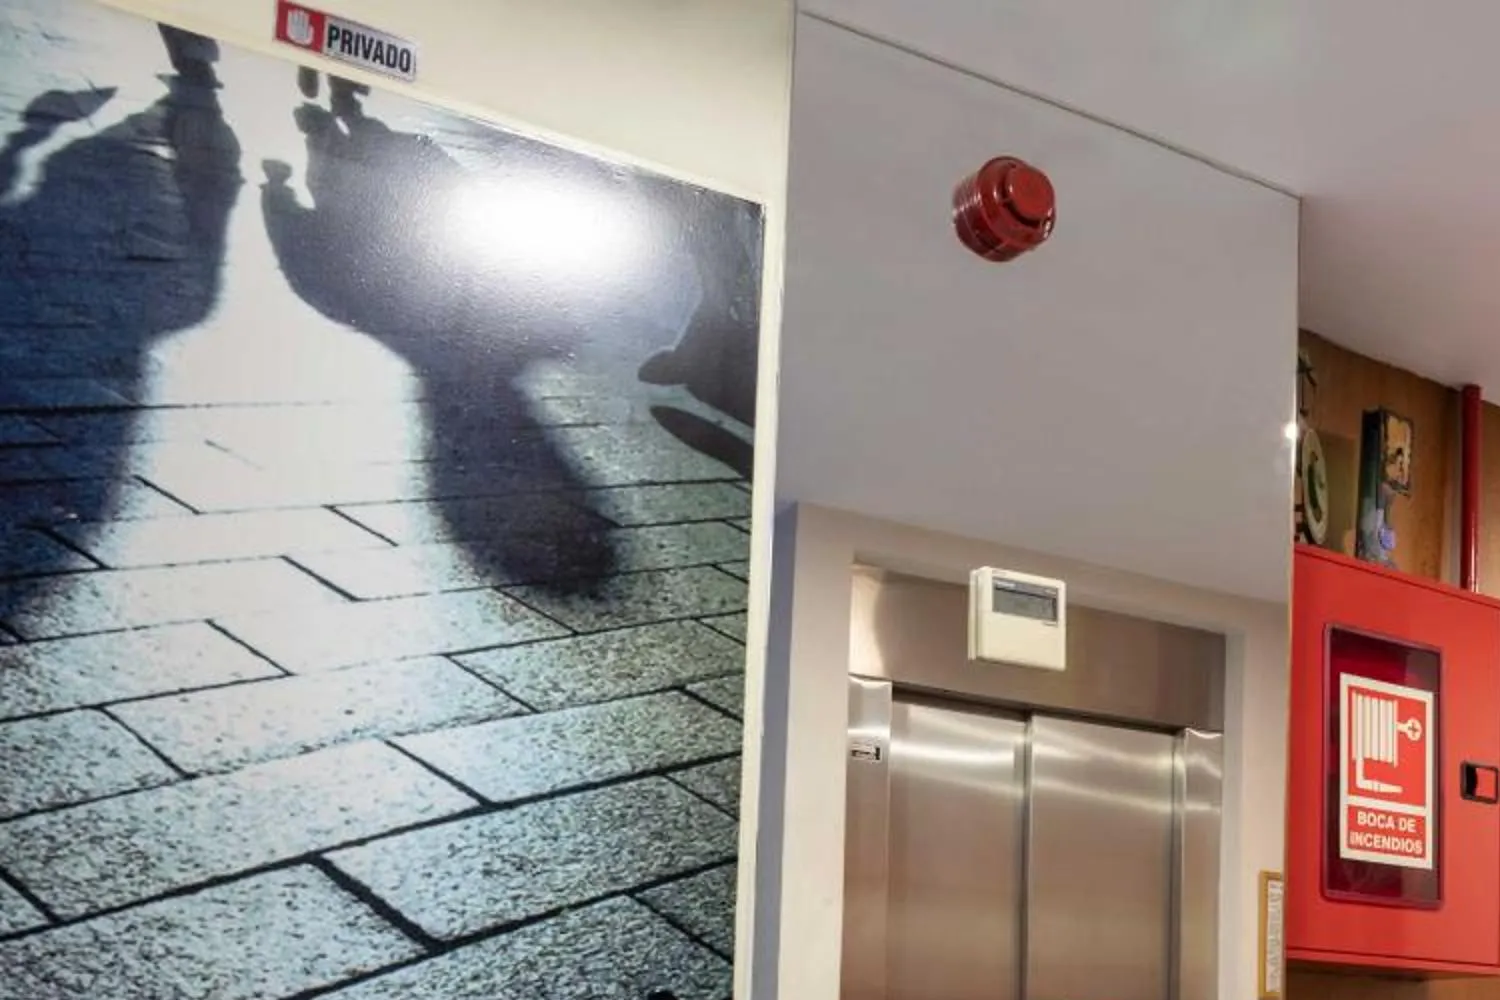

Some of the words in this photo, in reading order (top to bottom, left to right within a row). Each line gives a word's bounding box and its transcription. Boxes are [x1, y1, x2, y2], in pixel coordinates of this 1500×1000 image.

[327, 23, 412, 73] PRIVADO
[1357, 811, 1395, 831] BOCA
[1399, 817, 1417, 833] DE
[1349, 831, 1423, 855] INCENDIOS
